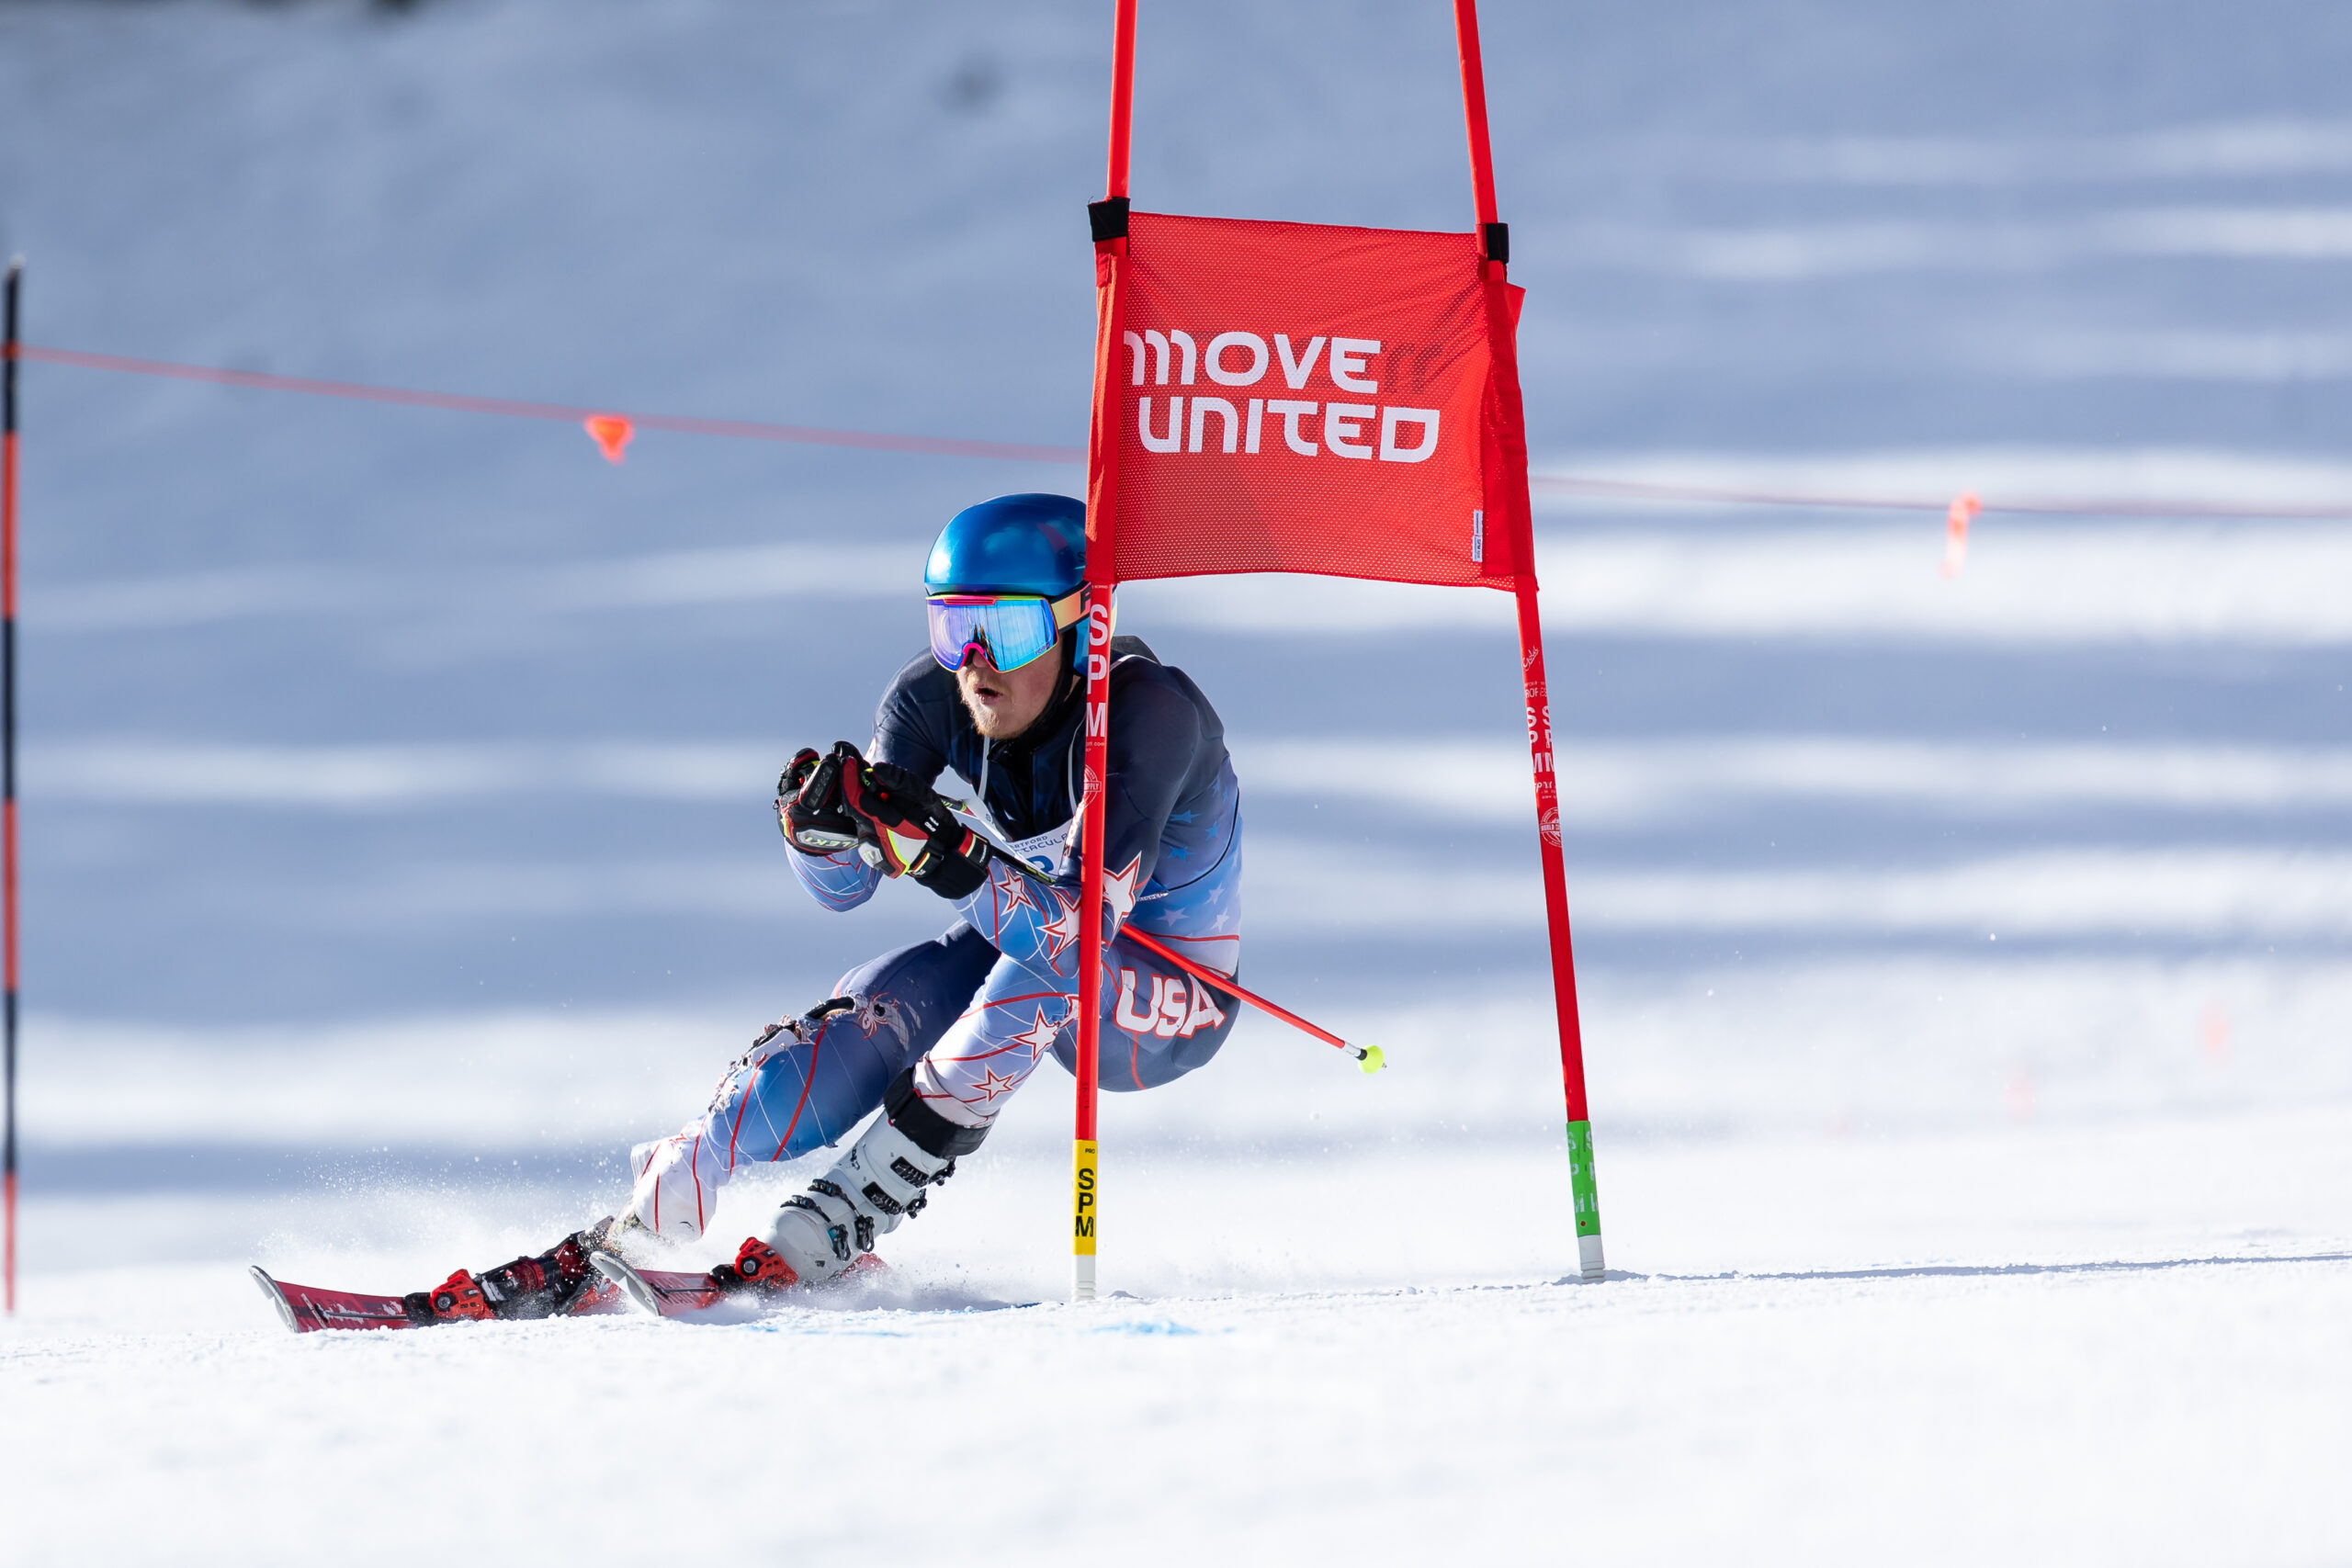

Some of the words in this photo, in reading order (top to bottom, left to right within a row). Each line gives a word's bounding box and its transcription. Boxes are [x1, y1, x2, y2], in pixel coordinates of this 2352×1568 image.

[1124, 329, 1381, 395] MOVE
[1138, 396, 1441, 464] UNITED
[1086, 603, 1108, 738] SPM
[1113, 966, 1227, 1039] USA
[1074, 1168, 1094, 1238] SPM
